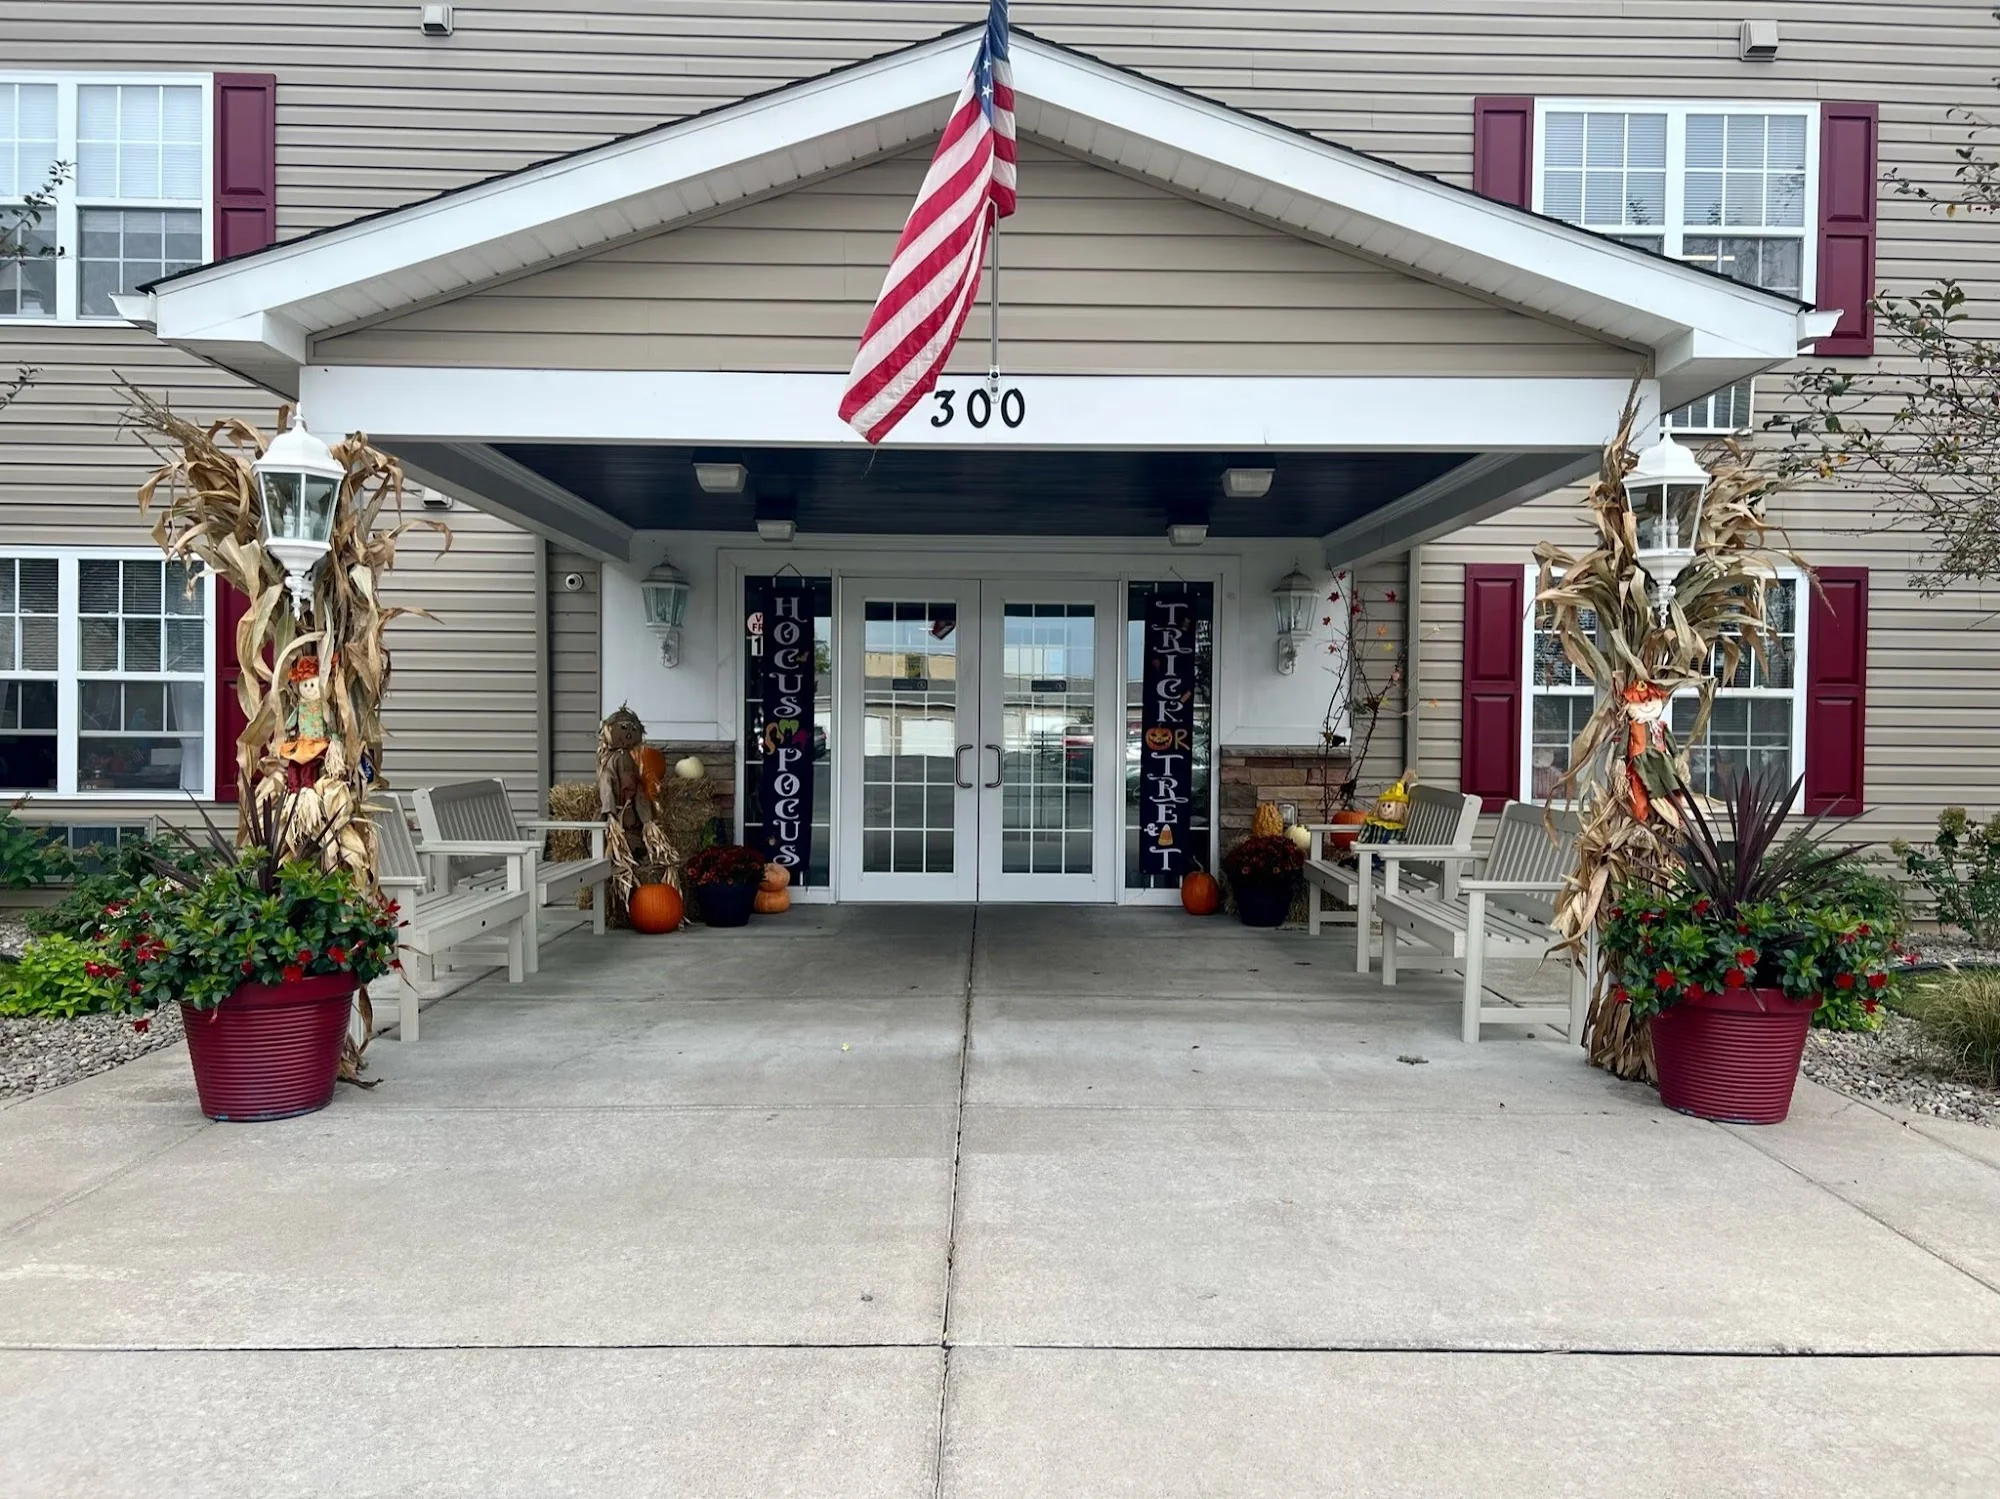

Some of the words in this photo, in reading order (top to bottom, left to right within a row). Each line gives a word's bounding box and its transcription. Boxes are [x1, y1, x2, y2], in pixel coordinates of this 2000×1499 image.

[930, 387, 1025, 429] 300
[769, 596, 808, 718] HOCUS
[1151, 600, 1193, 723] TRICK
[772, 747, 803, 867] POCUS
